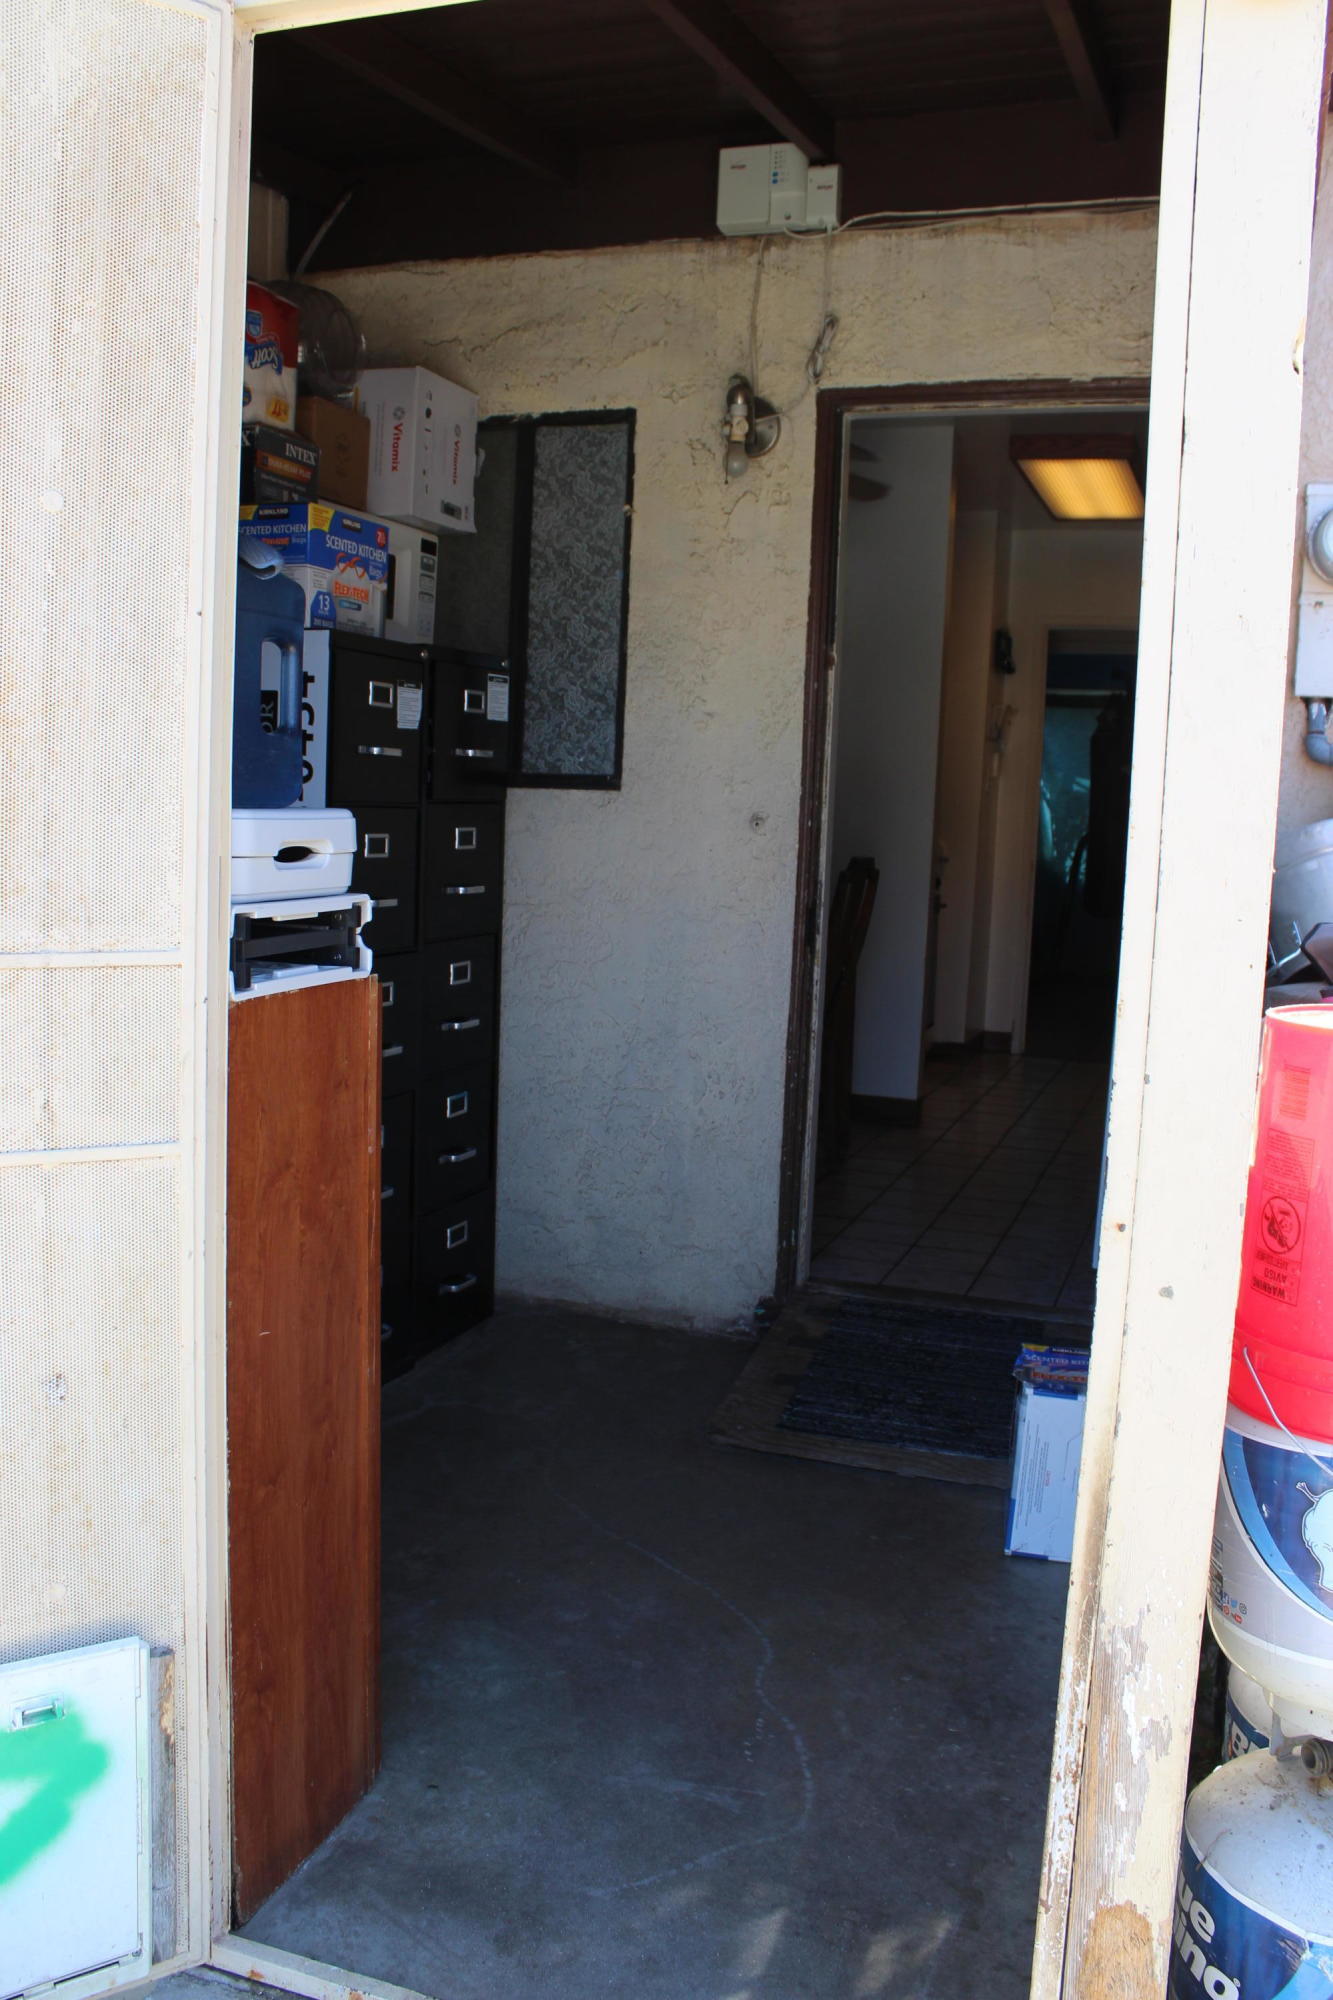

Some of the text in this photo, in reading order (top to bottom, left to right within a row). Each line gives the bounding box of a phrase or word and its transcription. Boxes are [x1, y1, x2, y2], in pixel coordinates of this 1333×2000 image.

[251, 346, 278, 369] Scott
[285, 442, 316, 466] INTEX
[391, 423, 404, 472] Vitamix
[272, 523, 306, 534] KITCHEN
[325, 534, 358, 555] SCENTED
[358, 544, 387, 563] KITCHEN
[318, 594, 330, 612] 13
